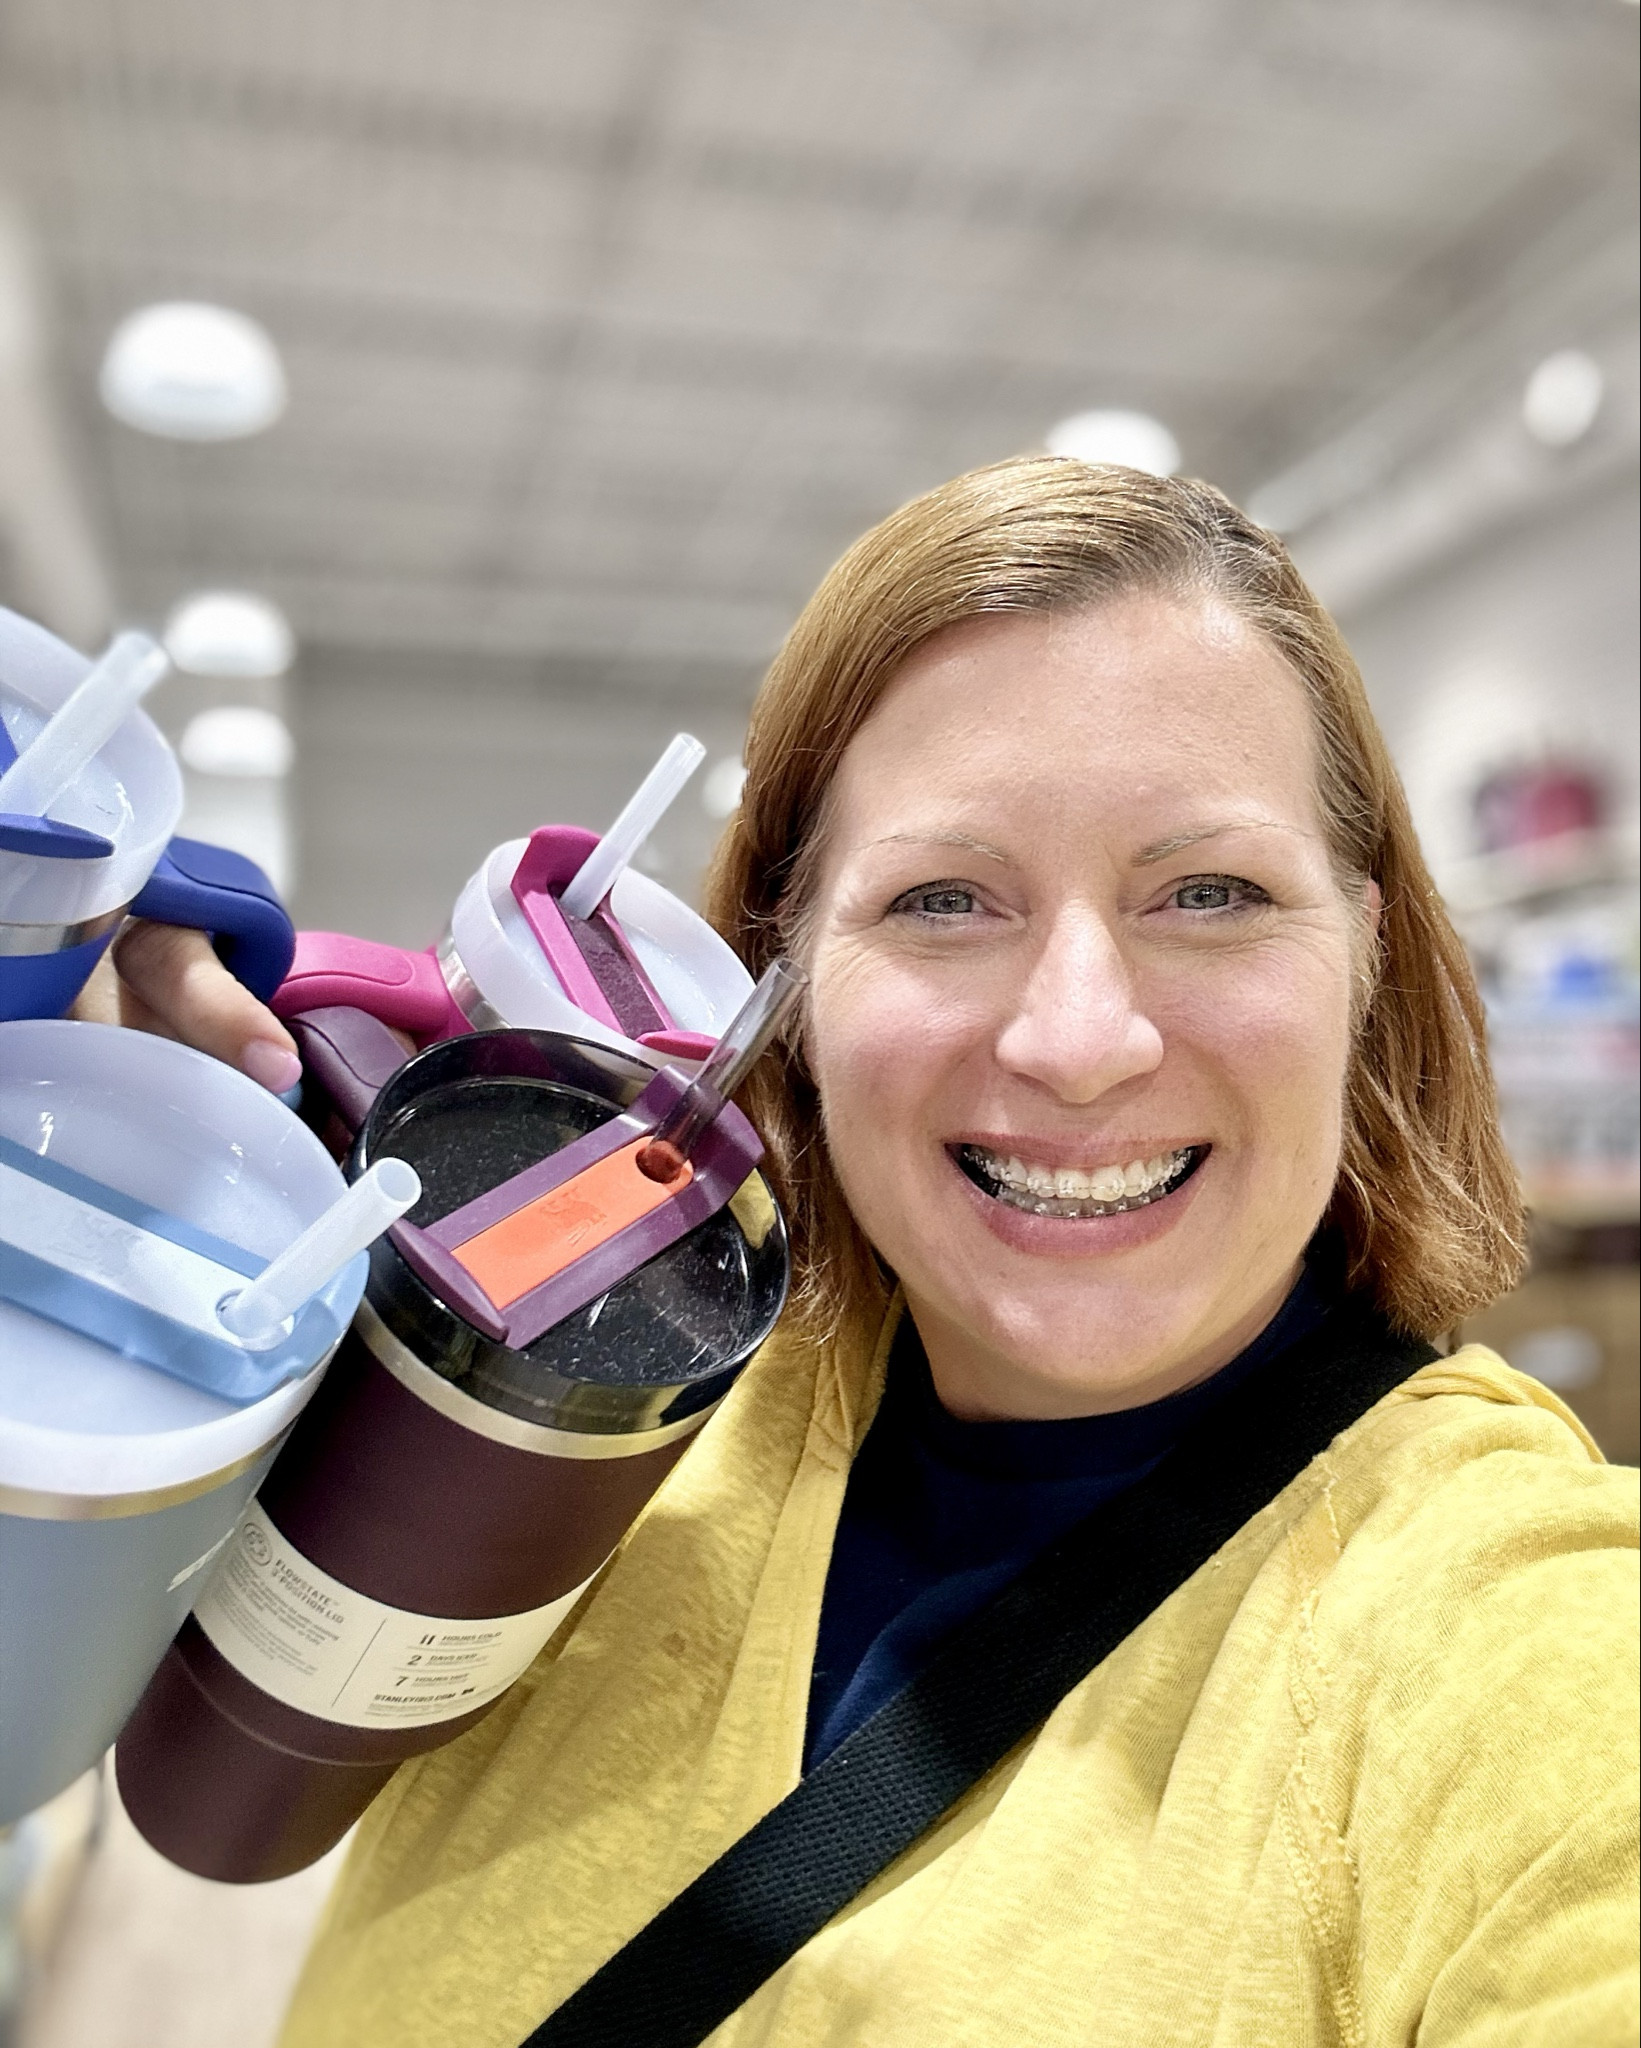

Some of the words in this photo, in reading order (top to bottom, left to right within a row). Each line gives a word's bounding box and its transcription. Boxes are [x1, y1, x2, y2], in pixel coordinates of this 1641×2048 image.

[419, 1634, 436, 1645] 11
[406, 1654, 422, 1666] 2
[395, 1675, 409, 1687] 7
